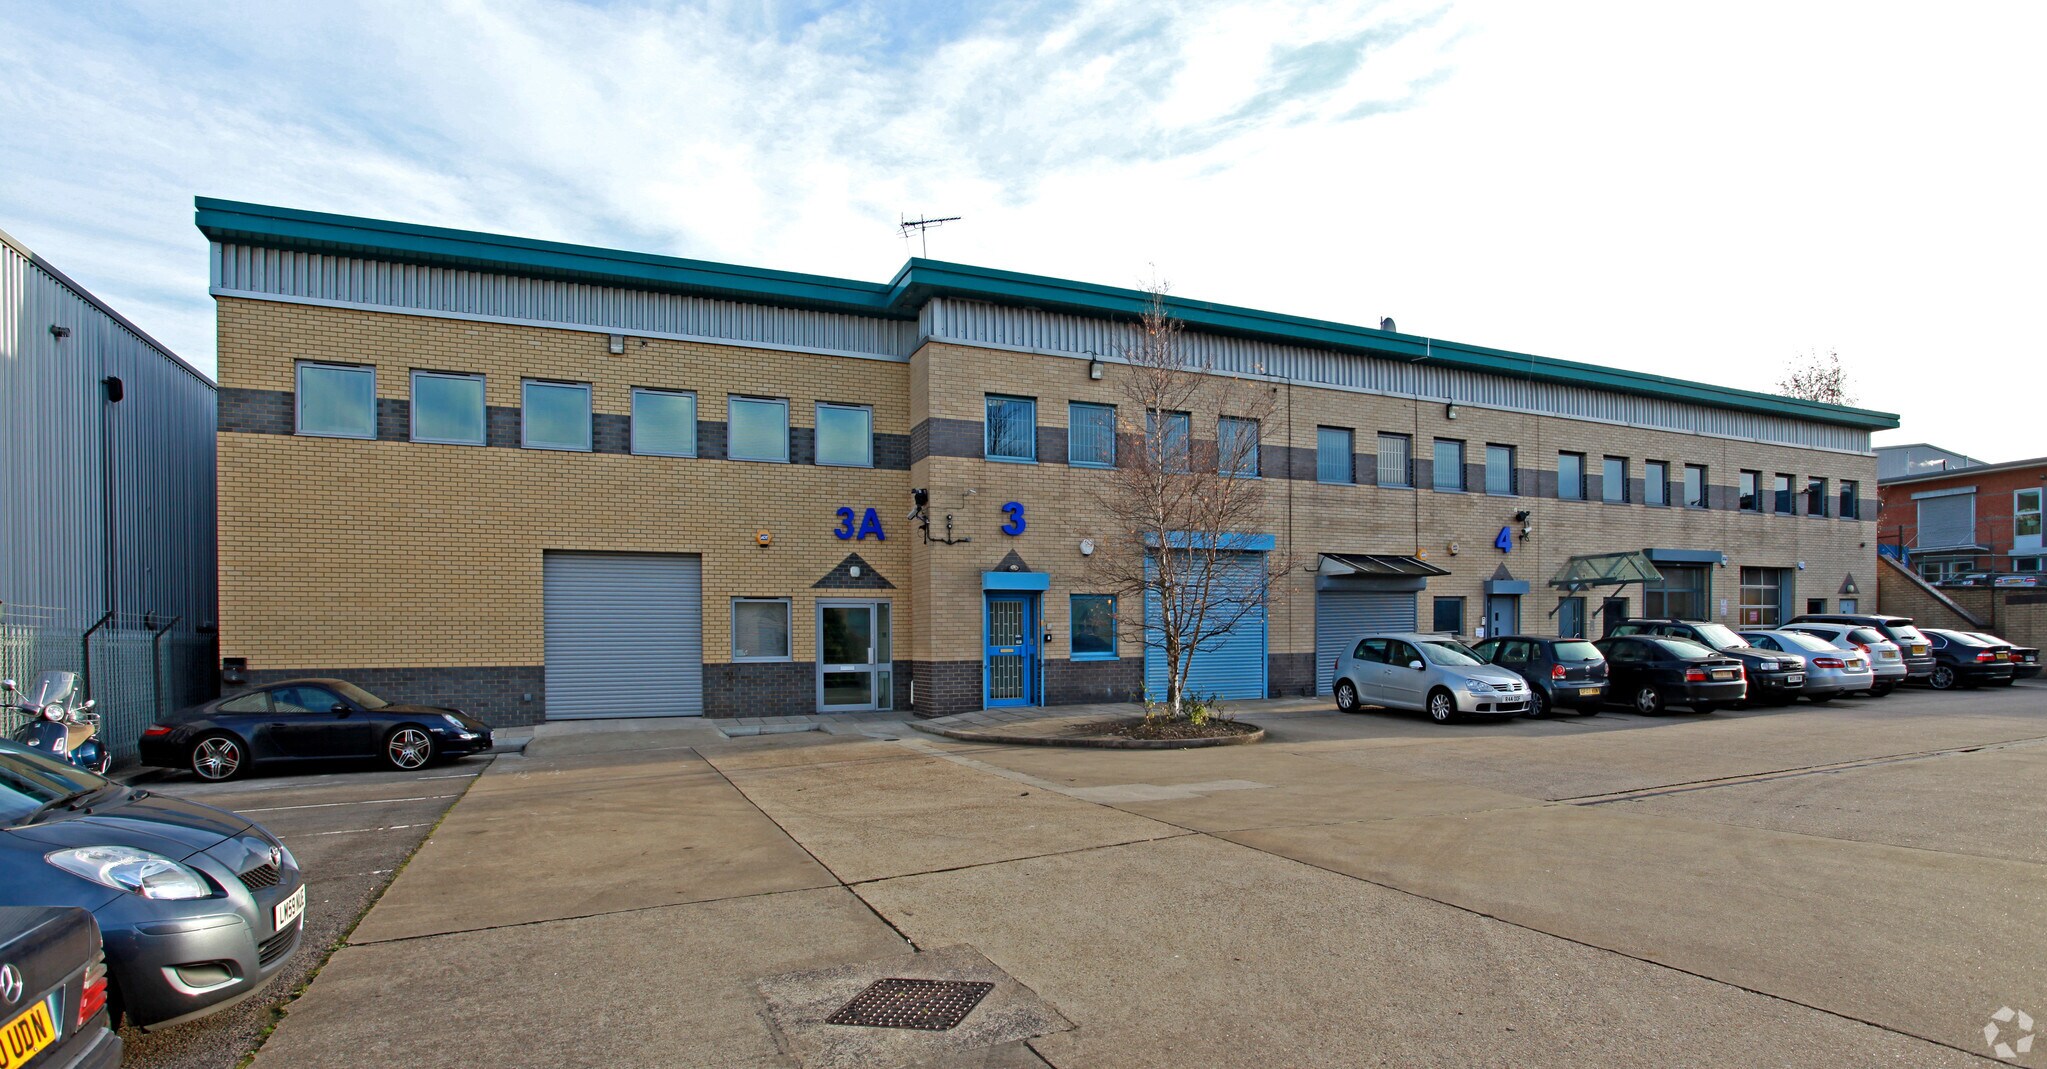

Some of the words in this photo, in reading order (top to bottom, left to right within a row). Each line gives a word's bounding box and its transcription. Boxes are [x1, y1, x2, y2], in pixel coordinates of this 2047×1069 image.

[834, 506, 886, 541] 3A
[1001, 501, 1026, 536] 3
[1495, 526, 1512, 553] 4
[7, 1009, 47, 1058] UDN
